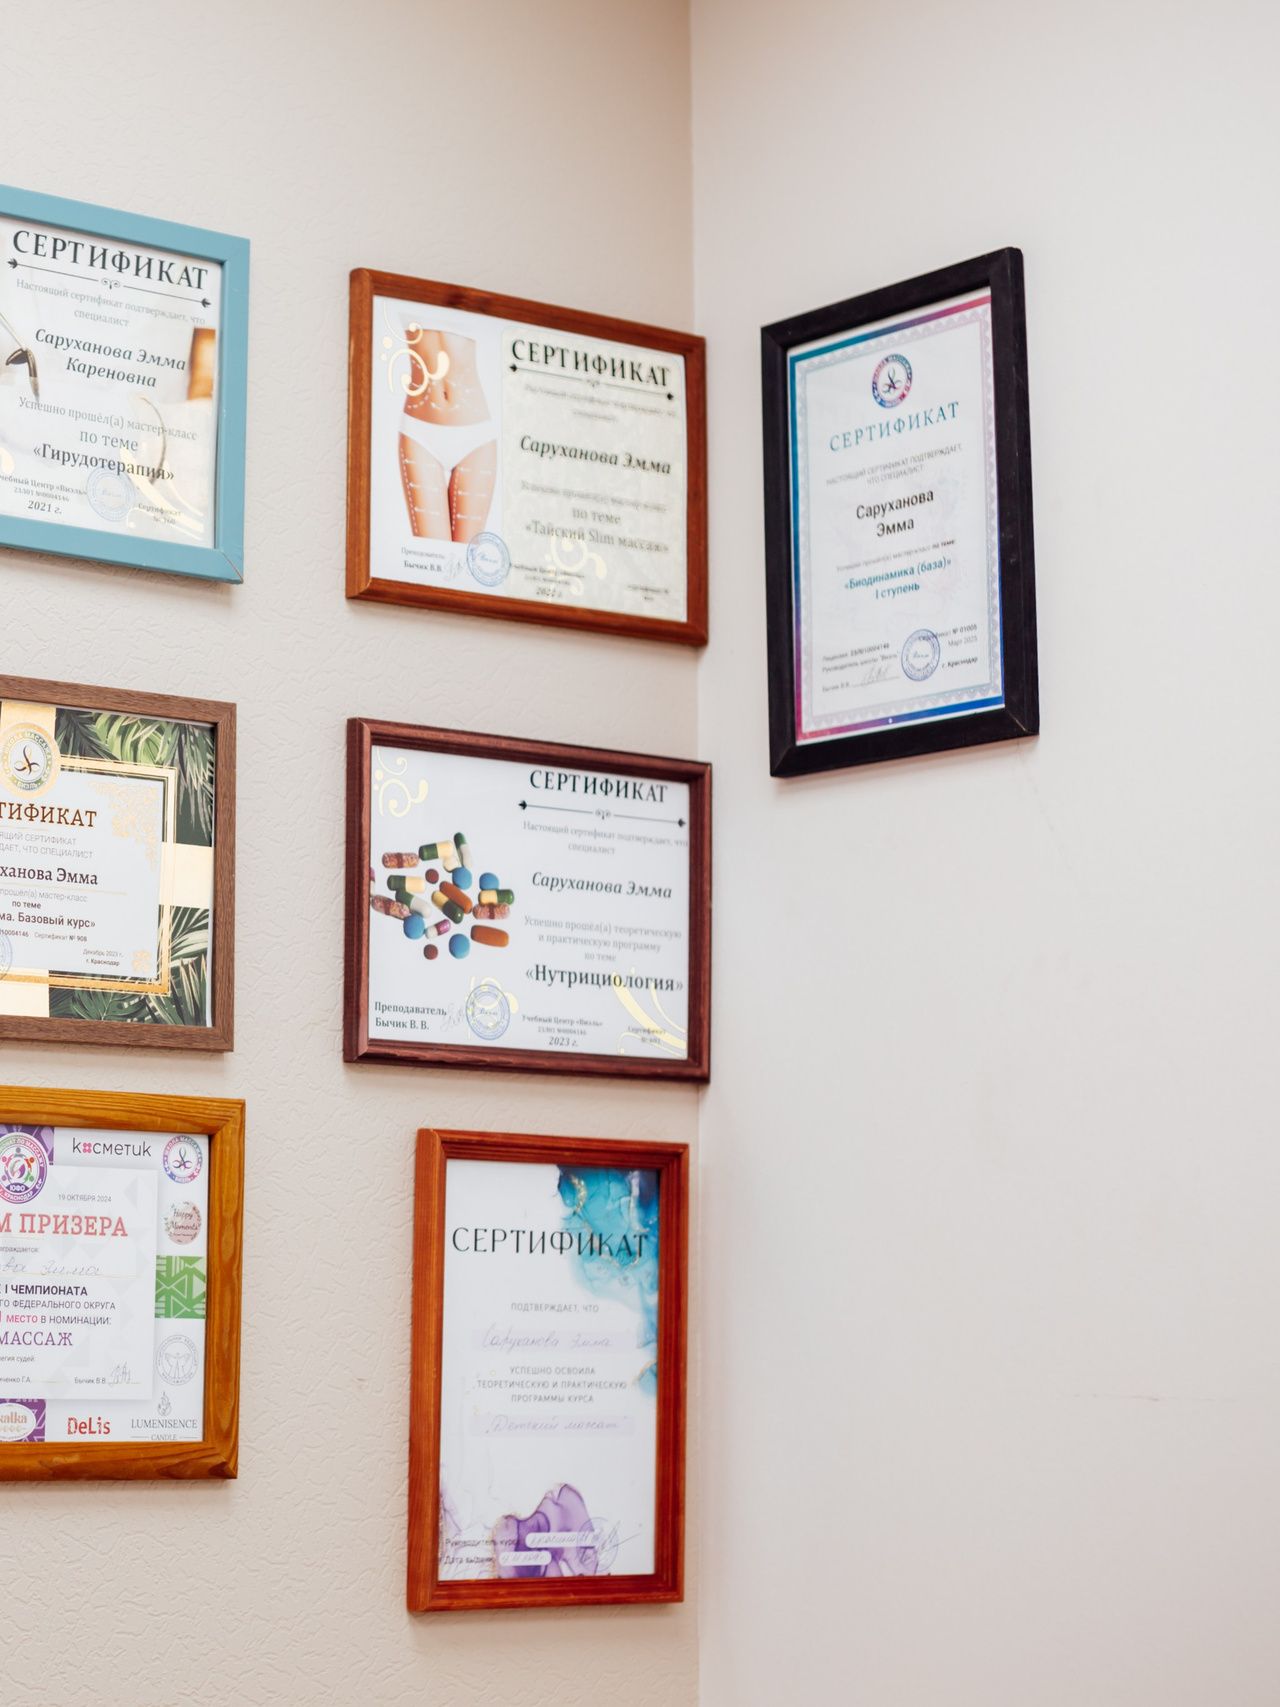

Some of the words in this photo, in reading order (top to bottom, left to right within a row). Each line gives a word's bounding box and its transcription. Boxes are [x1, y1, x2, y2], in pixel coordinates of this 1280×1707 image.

[13, 230, 208, 290] СЕРТИФИКАТ
[17, 279, 69, 297] Настоящий
[70, 290, 123, 309] сертификат
[125, 302, 189, 323] подтверждает,
[191, 316, 205, 325] что
[74, 309, 130, 327] специалист
[35, 328, 132, 361] Саруханова
[137, 349, 187, 371] Эмма
[512, 339, 670, 386] СЕРТИФИКАТ
[66, 357, 157, 387] Кареновна
[19, 397, 66, 416] Успешно
[69, 410, 125, 429] прошёл(а)
[127, 420, 197, 441] мастер-класс
[830, 401, 959, 452] СЕРТИФИКАТ
[80, 431, 98, 444] по
[102, 435, 138, 451] теме
[33, 443, 175, 481] «Гирудотерапия»
[520, 435, 618, 466] Саруханова
[623, 452, 671, 474] Эмма
[28, 500, 52, 513] 2021
[856, 490, 934, 520] Саруханова
[572, 508, 588, 520] по
[876, 517, 915, 538] Эмма
[588, 530, 615, 545] Slim
[844, 565, 915, 589] «Биодинамика
[917, 556, 952, 575] (база)»
[881, 583, 920, 599] ступень
[530, 769, 669, 803] СЕРТИФИКАТ
[25, 833, 77, 846] СЕРТИФИКАТ
[23, 844, 38, 854] ЧТО
[40, 846, 93, 859] СПЕЦИАЛИСТ
[56, 867, 98, 885] Эмма
[531, 871, 623, 895] Саруханова
[627, 880, 673, 899] Эмма
[0, 888, 38, 900] прошёл(а)
[39, 892, 88, 903] мастер-класс
[12, 900, 21, 908] по
[23, 901, 41, 910] теме
[18, 912, 64, 926] Базовый
[67, 918, 96, 929] курс»
[524, 915, 563, 930] Успешно
[566, 920, 612, 936] прошёл(а)
[614, 925, 683, 939] теоретическую
[546, 933, 610, 950] практическую
[525, 964, 684, 993] «Нутрициология»
[374, 1001, 447, 1017] Преподаватель
[375, 1017, 408, 1030] Бычик
[549, 1035, 569, 1047] 2023
[19, 1212, 128, 1237] ПРИЗЕРА
[452, 1227, 648, 1258] СЕРТИФИКАТ
[5, 1284, 8, 1294] I
[11, 1284, 88, 1296] ЧЕМПИОНАТА
[12, 1299, 81, 1309] ФЕДЕРАЛЬНОГО
[83, 1301, 116, 1310] ОКРУГА
[511, 1302, 580, 1313] ПОДТВЕРЖДАЕТ,
[582, 1304, 599, 1313] ЧТО
[6, 1314, 38, 1324] МЕСТО
[41, 1316, 46, 1324] В
[49, 1316, 112, 1325] НОМИНАЦИИ:
[510, 1367, 552, 1375] УСПЕШНО
[555, 1367, 595, 1375] ОСВОИЛА
[74, 1377, 94, 1385] Бычик
[477, 1379, 549, 1389] ТЕОРЕТИЧЕСКУЮ
[561, 1381, 627, 1390] ПРАКТИЧЕСКУЮ
[511, 1394, 565, 1403] ПРОГРАММЫ
[568, 1395, 594, 1403] КУРСА
[67, 1416, 111, 1435] DeLis
[131, 1419, 198, 1429] LUMENISENCE
